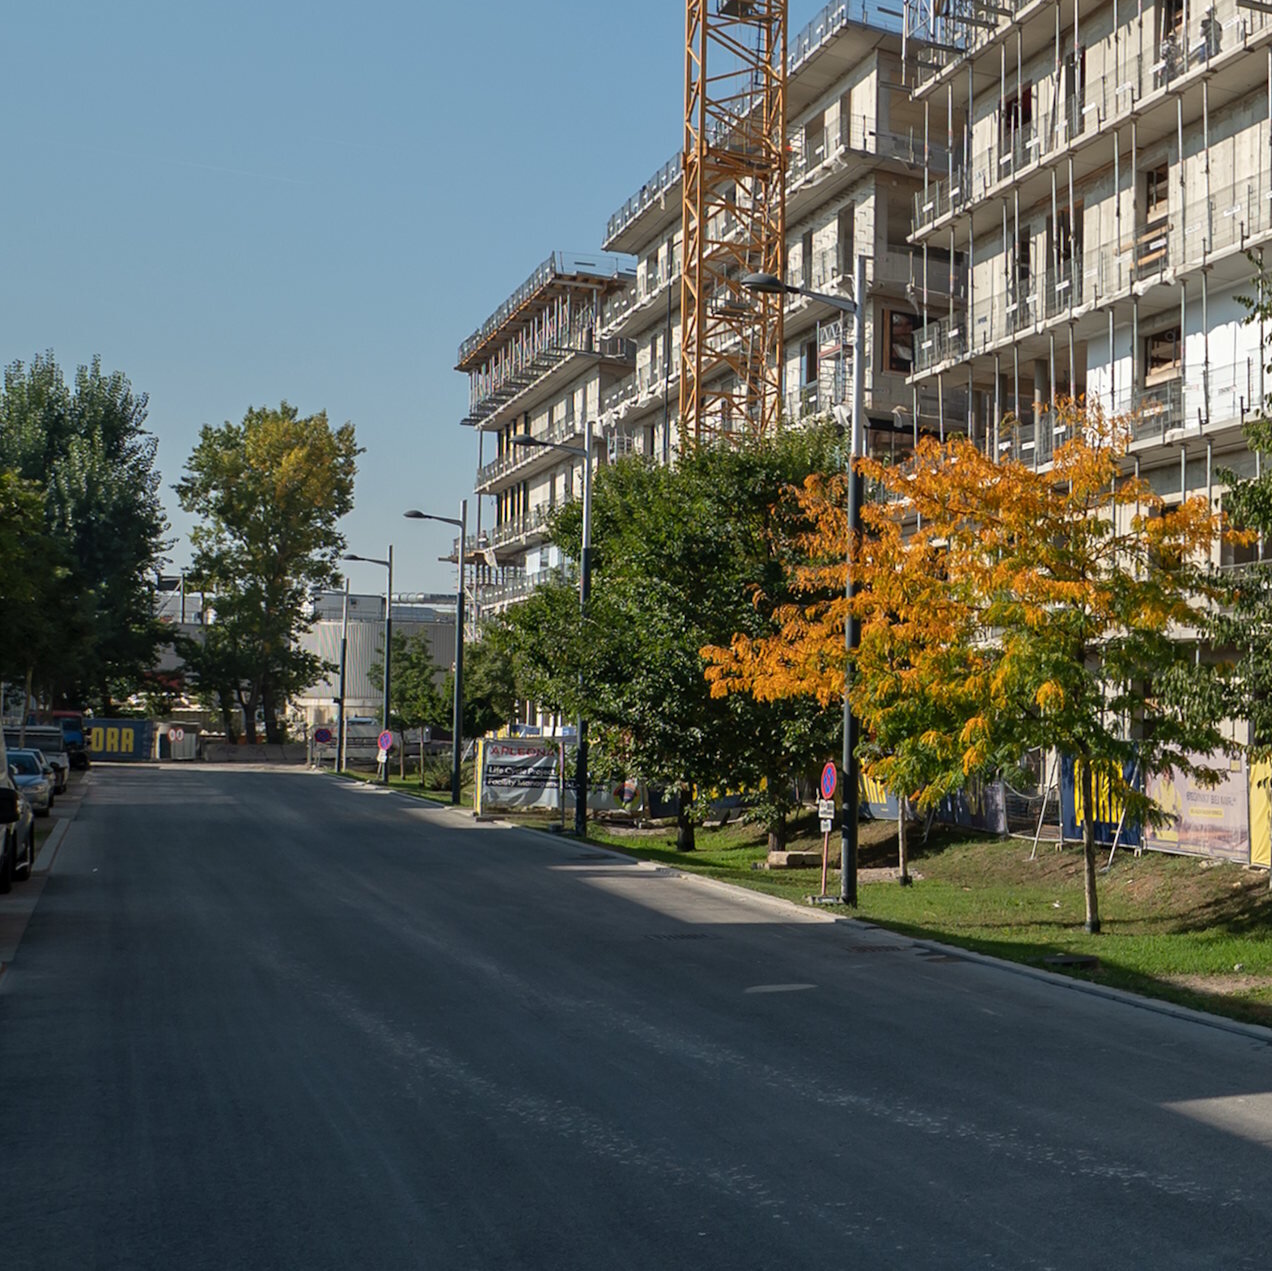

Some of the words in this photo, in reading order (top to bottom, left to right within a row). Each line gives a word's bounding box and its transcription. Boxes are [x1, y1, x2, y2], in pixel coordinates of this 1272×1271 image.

[91, 727, 135, 753] ORR
[488, 766, 503, 776] Life
[504, 766, 527, 777] Cycle
[487, 778, 516, 788] Facility
